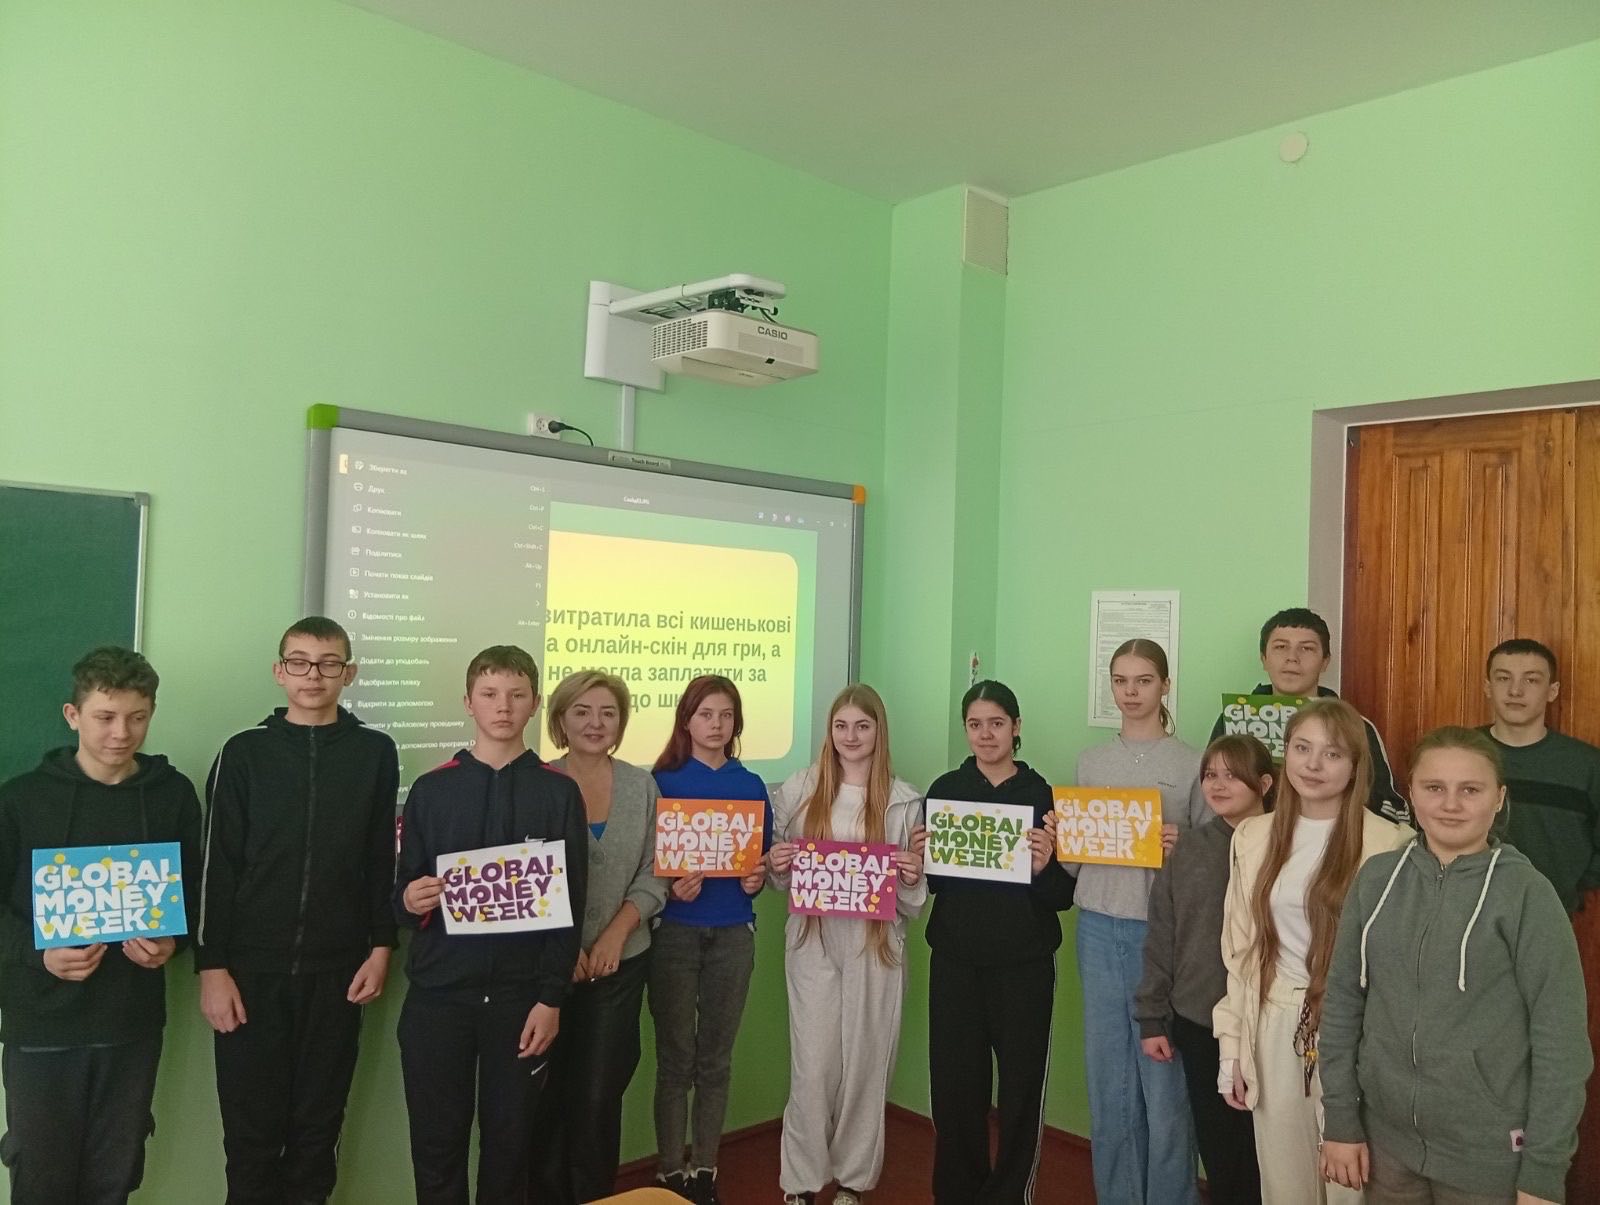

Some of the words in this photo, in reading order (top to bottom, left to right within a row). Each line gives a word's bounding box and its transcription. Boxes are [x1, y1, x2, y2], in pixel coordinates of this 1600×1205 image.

[757, 326, 788, 340] CASIO
[368, 484, 385, 495] Друк
[367, 506, 402, 516] Копіювати
[366, 527, 401, 537] Копіювати
[362, 612, 394, 621] Відомості
[395, 614, 408, 622] про
[408, 613, 425, 622] файл
[545, 608, 650, 630] витратила
[656, 610, 684, 629] всі
[690, 615, 791, 633] кишенькові
[565, 634, 687, 656] онлайн-скін
[692, 641, 727, 660] для
[733, 643, 766, 661] гри,
[771, 643, 781, 658] а
[360, 657, 385, 666] Додати
[385, 658, 395, 666] до
[395, 657, 430, 666] уподобань
[358, 678, 400, 687] Відобразити
[548, 665, 573, 681] не
[748, 668, 767, 682] за
[357, 700, 388, 708] Відкрити
[396, 700, 434, 709] допомогою
[1225, 720, 1286, 738] MON
[401, 742, 438, 750] допомогою
[1056, 817, 1151, 840] MONEY
[657, 831, 753, 851] MONEY
[930, 830, 1020, 852] MONEY
[1056, 835, 1135, 860] WEEK
[656, 850, 736, 872] WEEK
[929, 846, 1003, 869] WEEK
[444, 875, 552, 905] MONEY
[792, 870, 887, 893] MONEY
[35, 882, 168, 917] MONEY
[447, 898, 539, 922] WEEK
[790, 887, 868, 912] WEEK
[35, 907, 150, 940] WEEK
